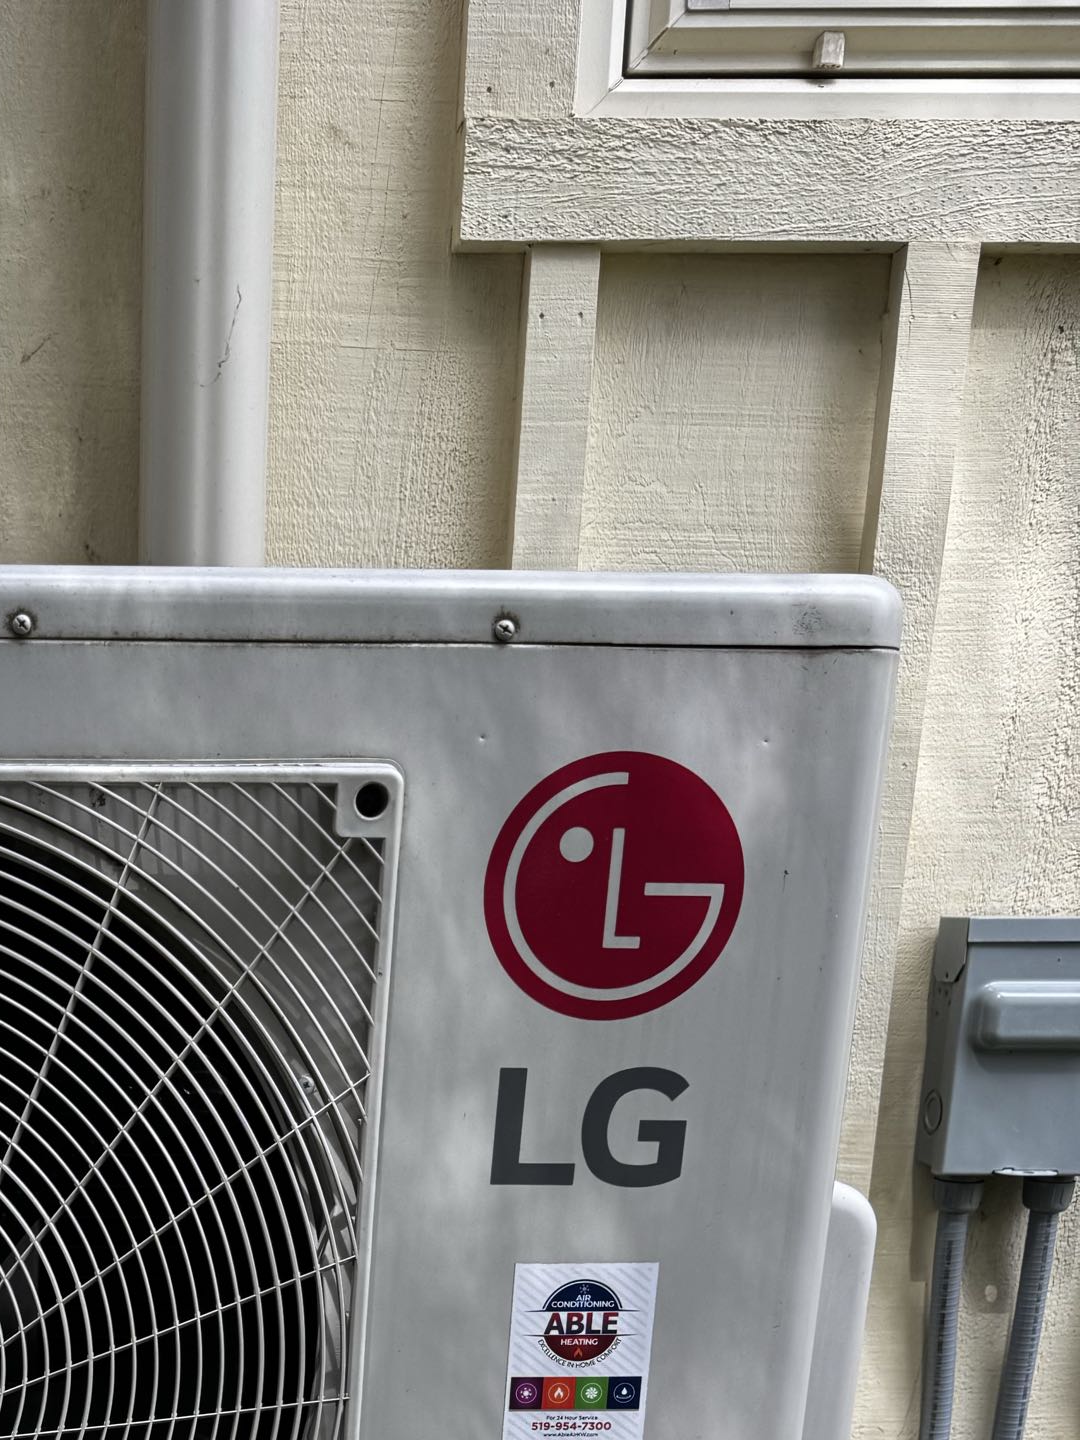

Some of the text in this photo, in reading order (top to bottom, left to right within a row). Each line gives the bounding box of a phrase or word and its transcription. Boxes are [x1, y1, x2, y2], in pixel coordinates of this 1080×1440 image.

[503, 771, 725, 1001] LG
[490, 1066, 690, 1188] LG
[543, 1312, 619, 1335] ABLE
[537, 1338, 567, 1367] EXCELLENCE
[575, 1359, 596, 1369] HOME
[596, 1337, 622, 1363] COMFORT
[560, 1338, 598, 1346] HEATING
[531, 1421, 612, 1431] 519-954-7300
